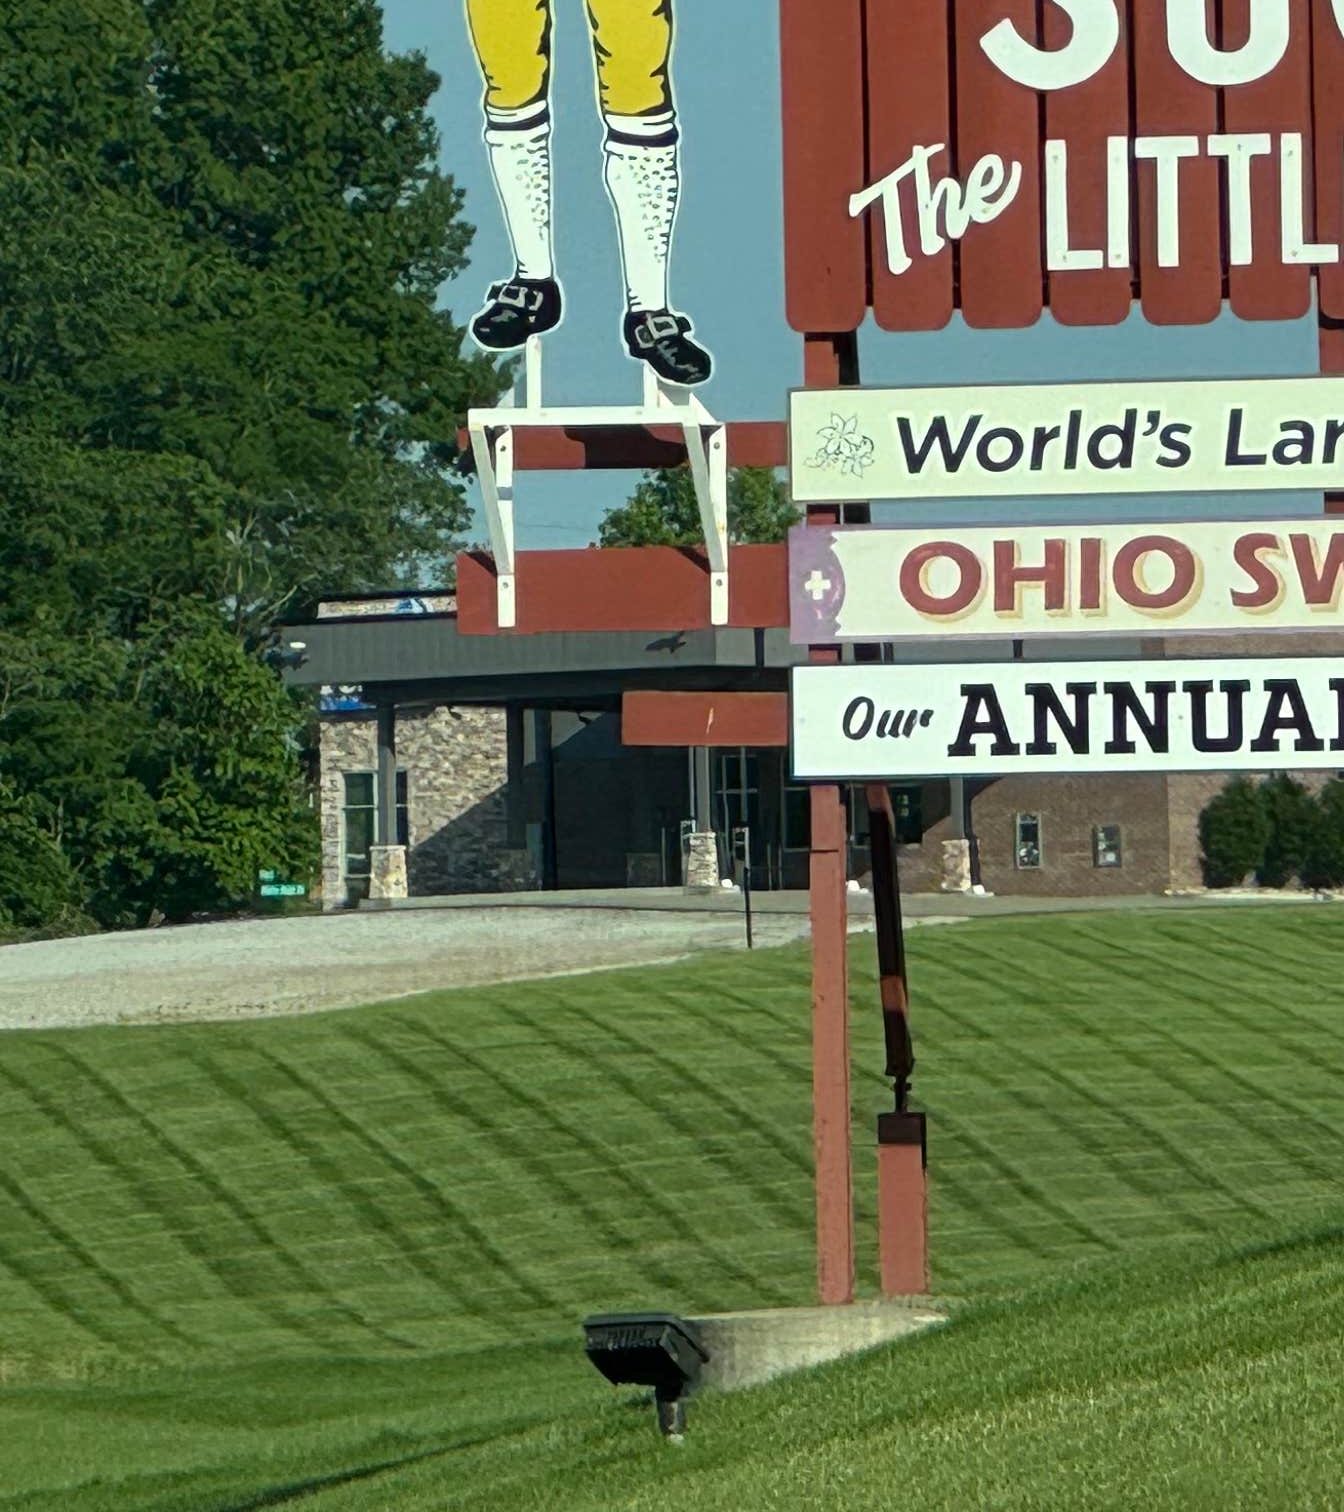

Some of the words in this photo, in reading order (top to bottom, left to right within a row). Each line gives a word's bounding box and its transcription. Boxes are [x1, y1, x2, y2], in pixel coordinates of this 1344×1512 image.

[848, 143, 1022, 275] The
[895, 408, 1192, 474] World's
[898, 534, 1201, 616] OHIO
[841, 694, 935, 741] Our
